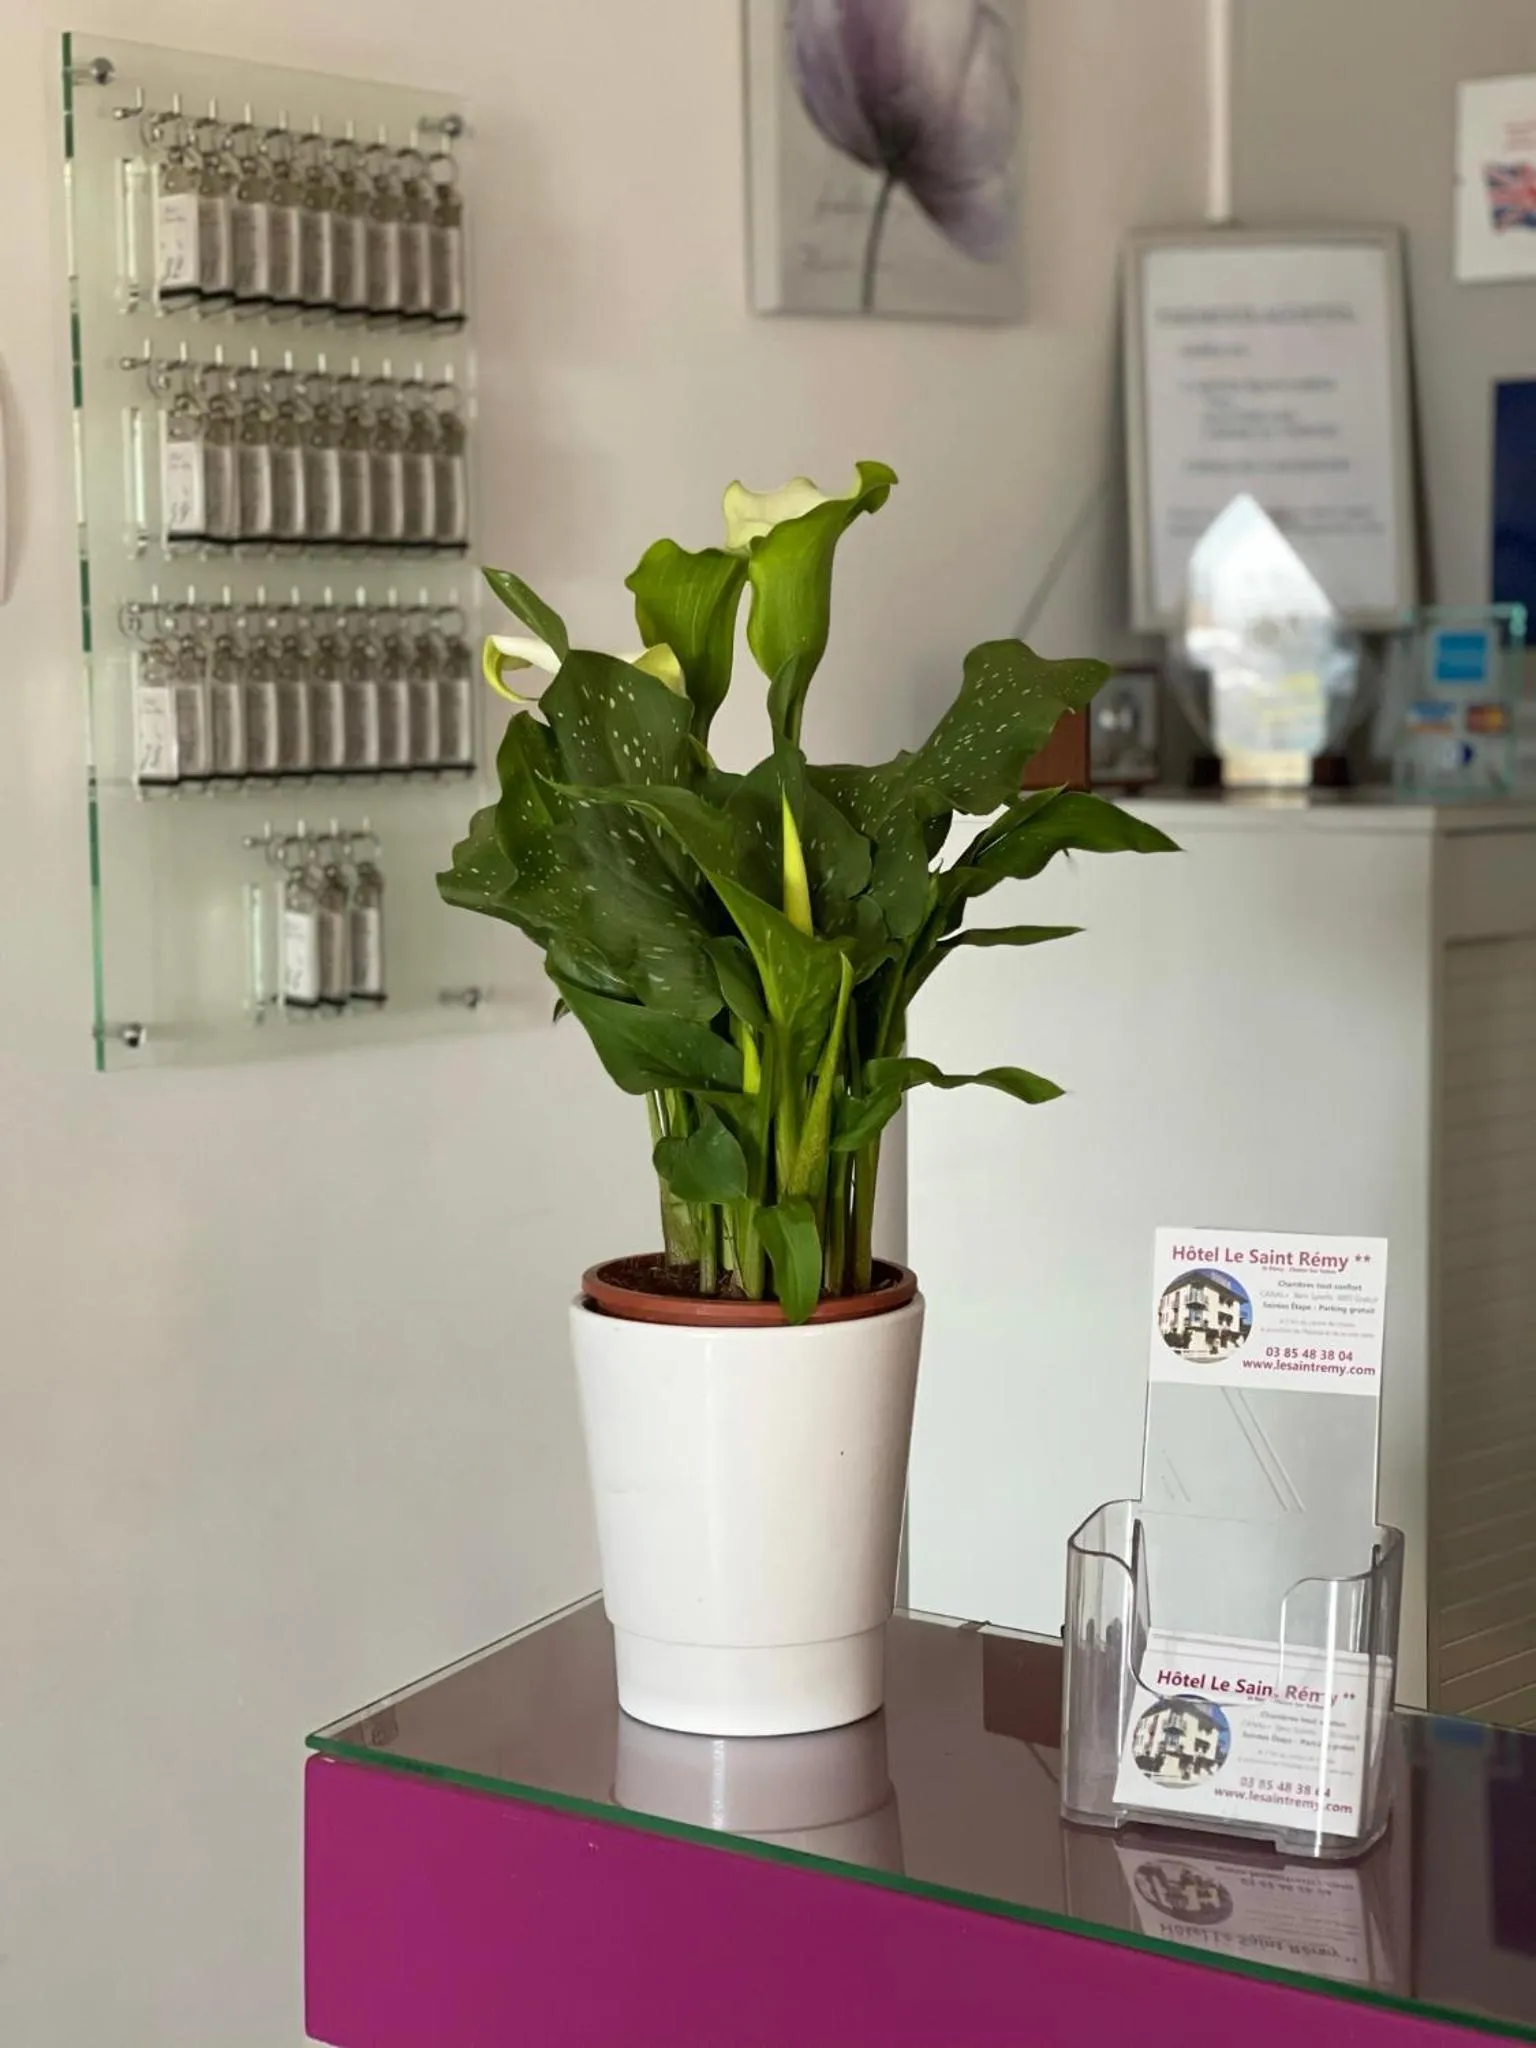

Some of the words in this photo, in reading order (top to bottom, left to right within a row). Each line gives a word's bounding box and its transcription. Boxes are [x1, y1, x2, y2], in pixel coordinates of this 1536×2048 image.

[1172, 1245, 1219, 1262] Hôtel
[1225, 1248, 1244, 1263] Le
[1249, 1249, 1293, 1266] Saint
[1299, 1251, 1349, 1272] Rémy
[1266, 1347, 1280, 1357] 03
[1284, 1347, 1299, 1358] 85
[1302, 1348, 1317, 1360] 48
[1320, 1350, 1335, 1361] 38
[1338, 1351, 1353, 1362] 04
[1242, 1357, 1376, 1376] www.lesaintremy.com
[1157, 1670, 1205, 1689] Hôtel
[1211, 1675, 1230, 1691] Le
[1276, 1781, 1292, 1793] 48
[1296, 1783, 1312, 1796] 38
